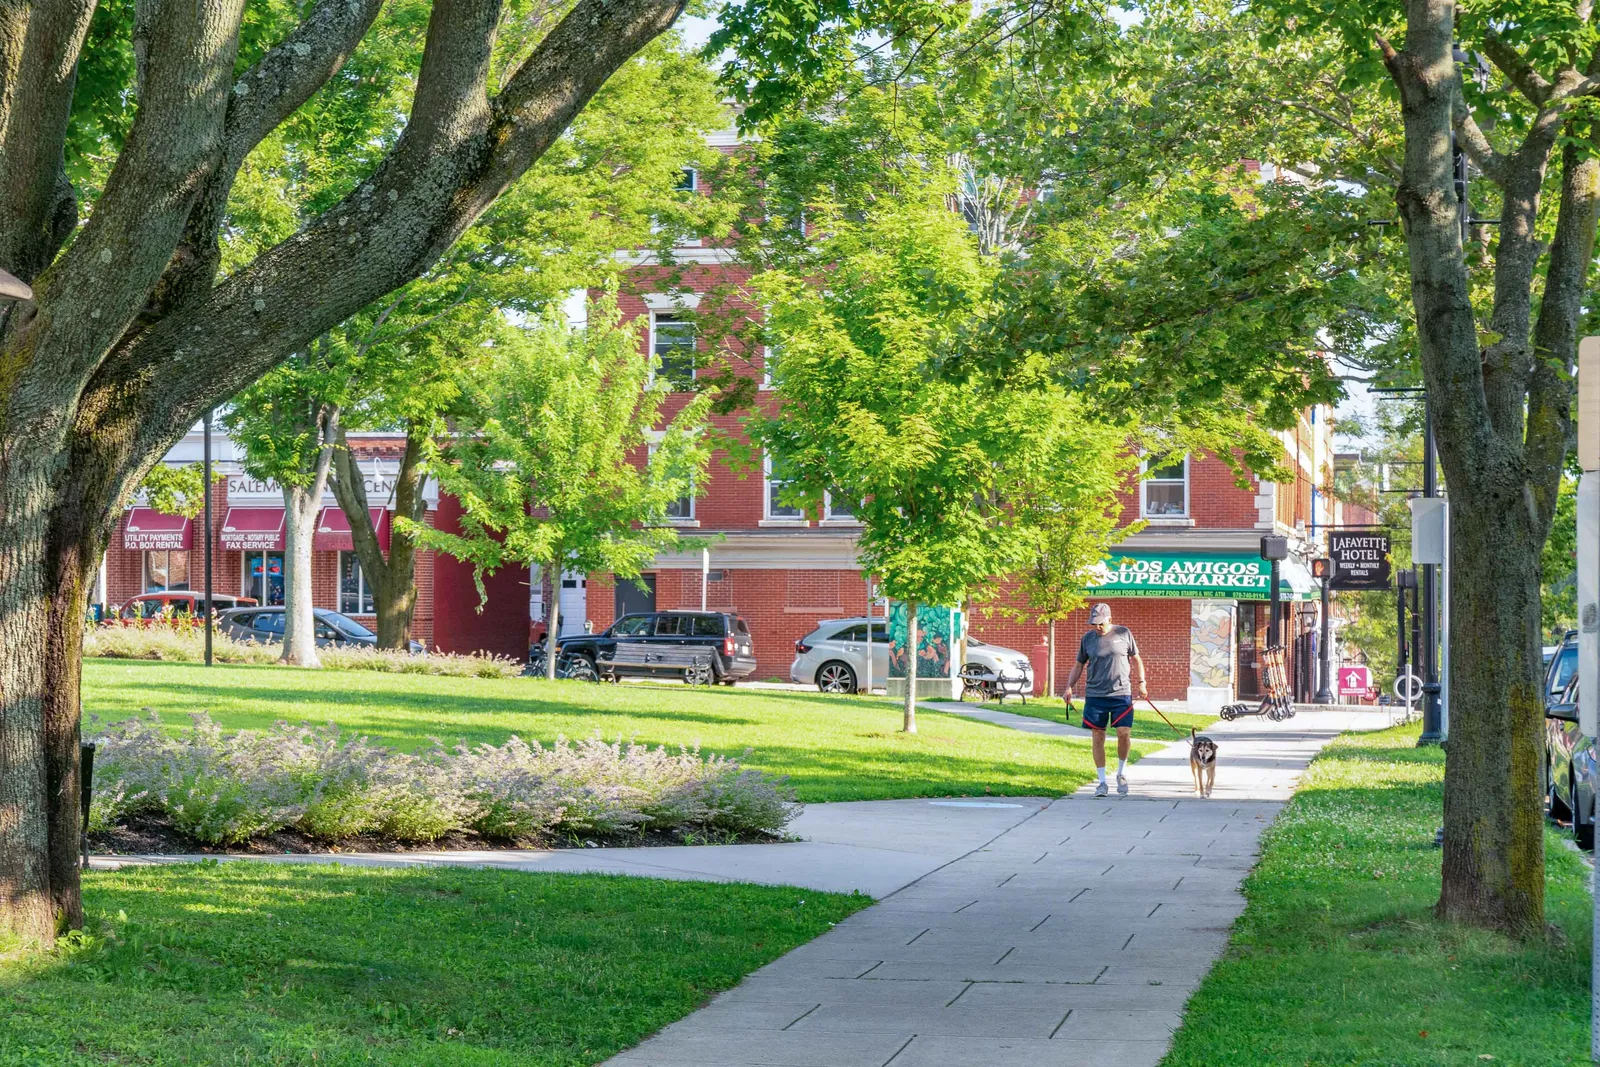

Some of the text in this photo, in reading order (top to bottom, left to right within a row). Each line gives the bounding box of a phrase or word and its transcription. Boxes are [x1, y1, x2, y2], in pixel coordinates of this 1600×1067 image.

[229, 480, 276, 493] SALEM
[125, 533, 183, 542] UTILITY PAYMENTS
[248, 533, 264, 542] NOTARY
[264, 533, 280, 542] PUBLIC
[125, 541, 183, 549] P.O. BOX RENTAL
[226, 541, 275, 549] FAX SERVICE
[1333, 537, 1387, 552] LAFAYETTE
[1341, 549, 1379, 560] HOTEL
[1118, 560, 1260, 575] LOS AMIGOS
[1105, 571, 1270, 587] SUPERMARKET
